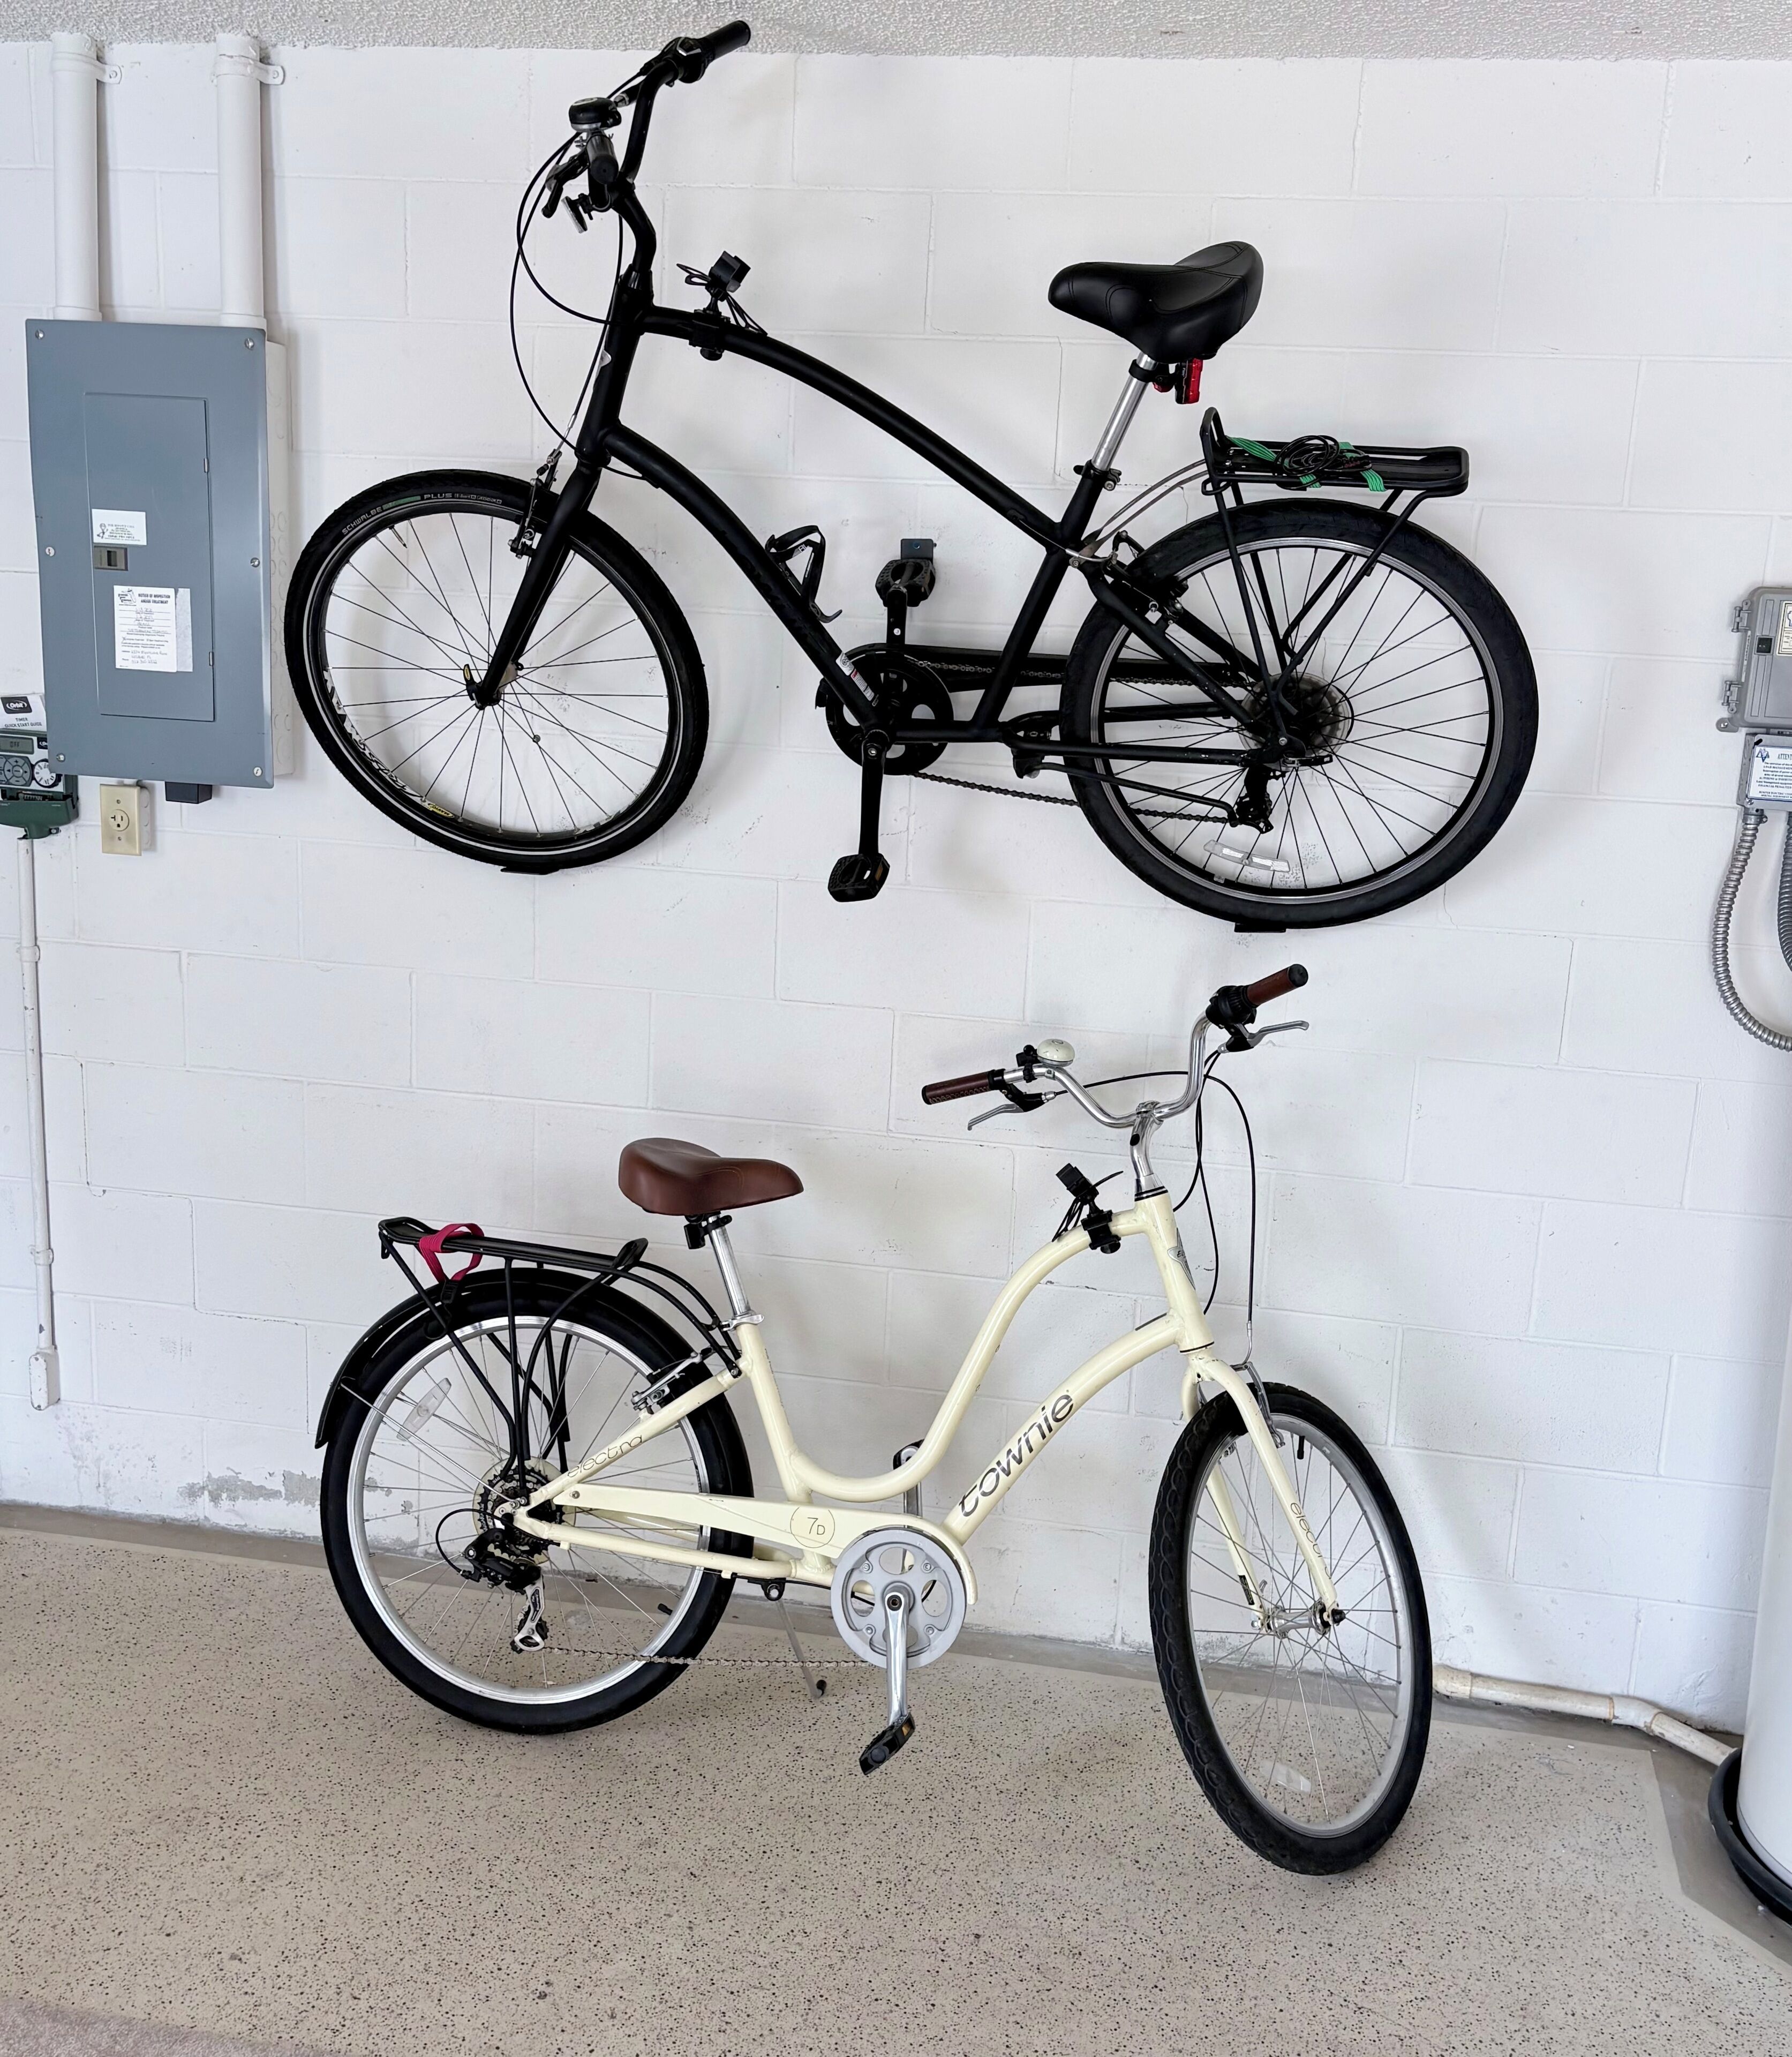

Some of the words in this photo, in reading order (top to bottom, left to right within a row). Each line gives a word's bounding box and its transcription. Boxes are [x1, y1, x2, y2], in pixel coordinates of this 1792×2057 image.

[342, 506, 382, 535] SCHWALBE
[567, 1434, 643, 1478] electra
[959, 1394, 1074, 1517] townie
[807, 1517, 826, 1535] 7D
